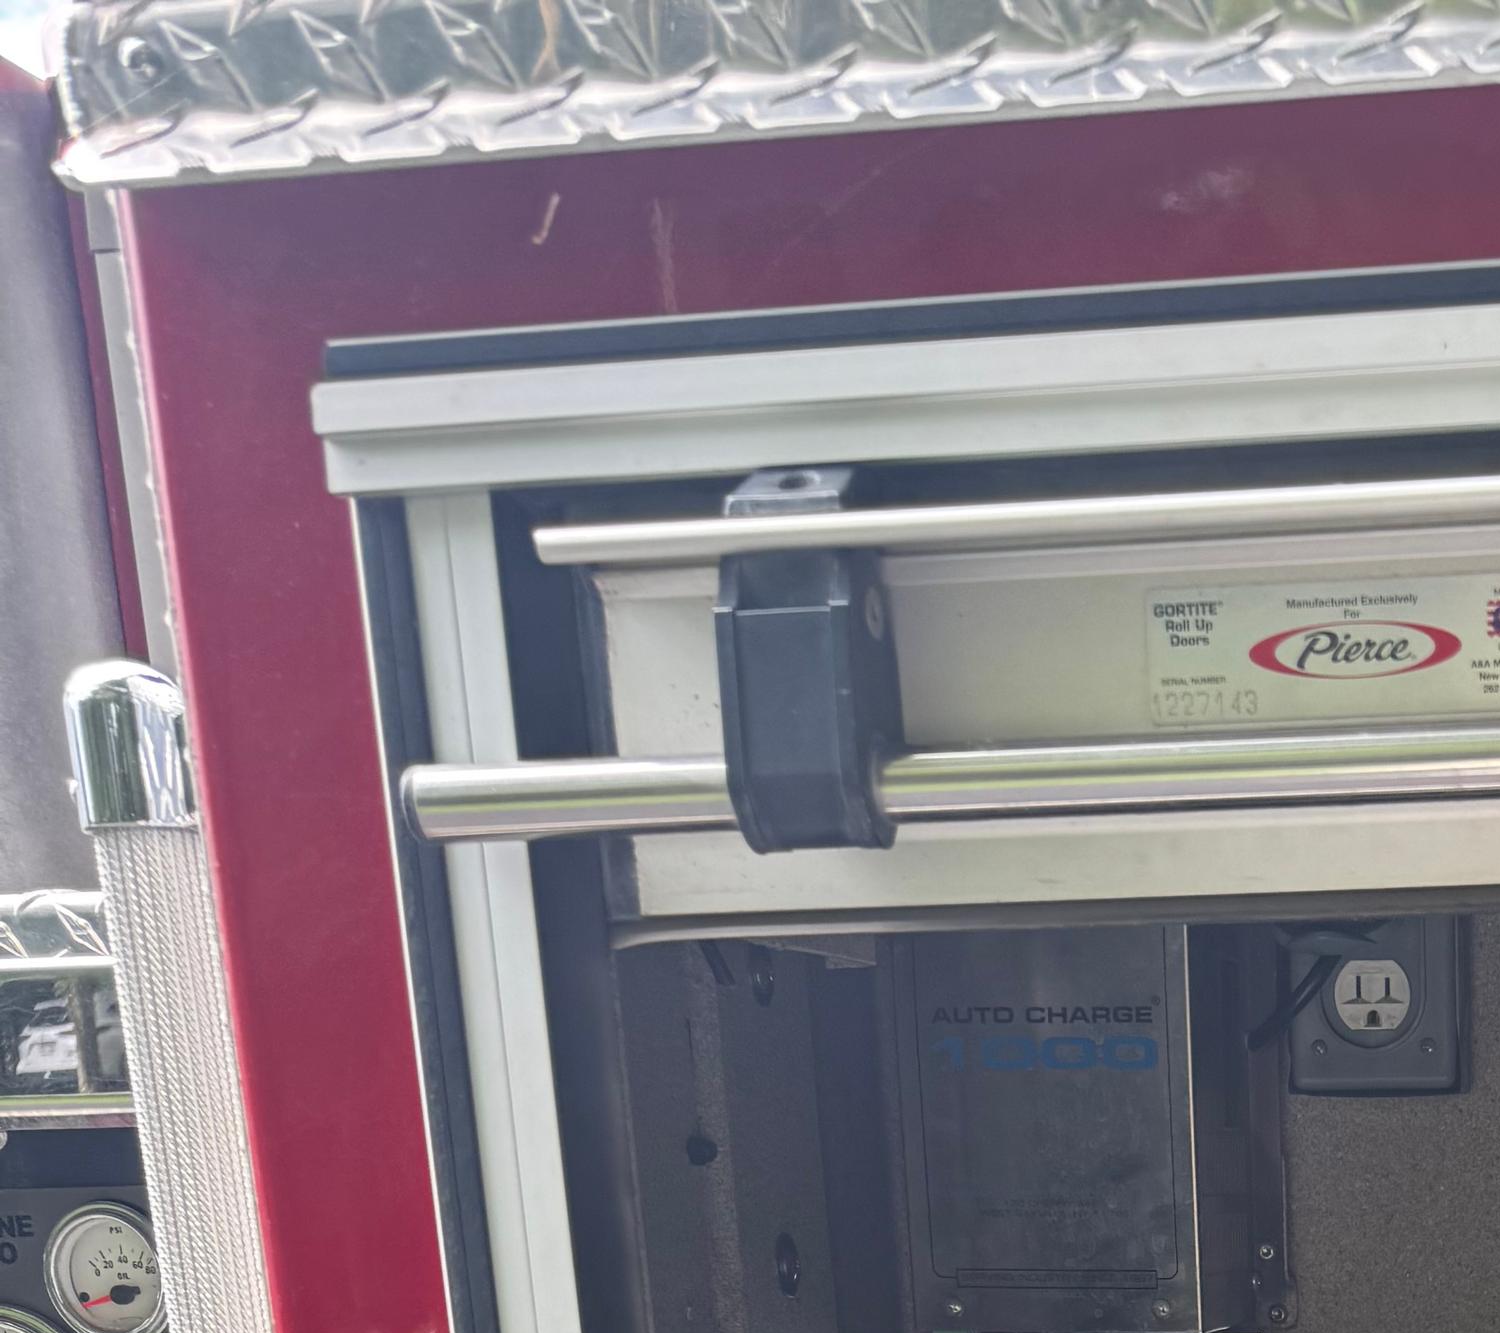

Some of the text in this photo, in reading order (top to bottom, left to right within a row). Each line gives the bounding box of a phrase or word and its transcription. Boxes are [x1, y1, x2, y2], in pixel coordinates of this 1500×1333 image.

[1286, 593, 1418, 609] Manufactured Exclusively
[1153, 601, 1218, 618] GORTITE
[1343, 608, 1360, 619] For
[1165, 619, 1213, 633] Roll Up
[1170, 635, 1210, 647] Doors
[1297, 631, 1411, 669] Pierce
[1480, 672, 1499, 681] New
[932, 1006, 1153, 1025] AUTO CHARGE
[109, 1226, 122, 1234] PSI
[103, 1260, 113, 1269] 20
[117, 1256, 128, 1264] 40
[132, 1260, 143, 1269] 60
[95, 1268, 100, 1277] 0
[145, 1265, 156, 1274] 80
